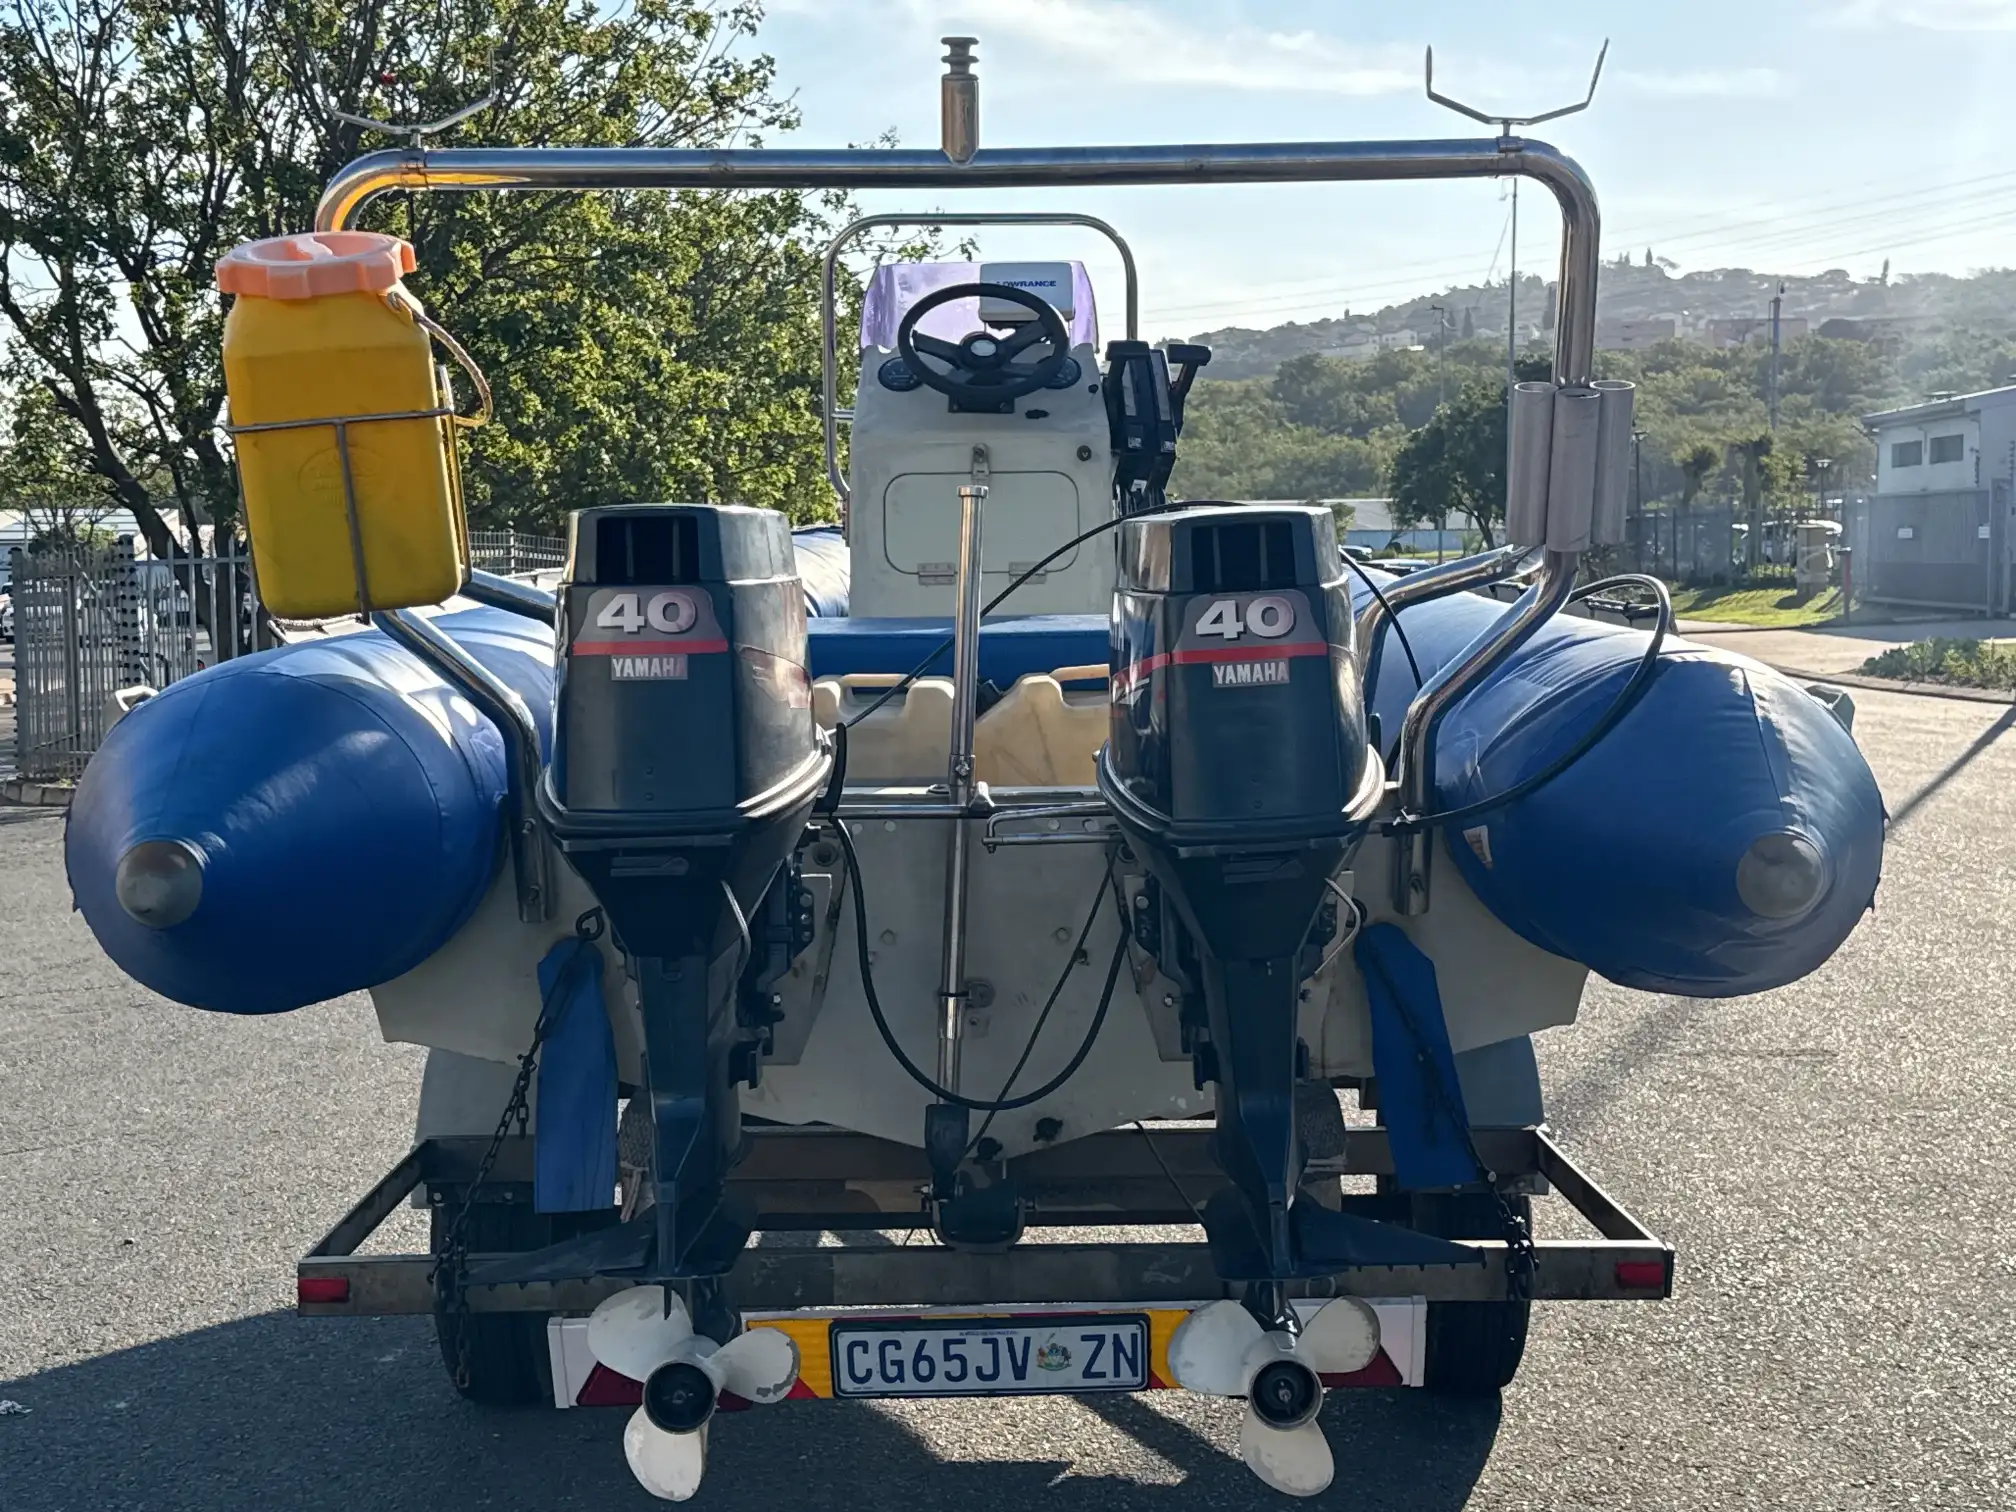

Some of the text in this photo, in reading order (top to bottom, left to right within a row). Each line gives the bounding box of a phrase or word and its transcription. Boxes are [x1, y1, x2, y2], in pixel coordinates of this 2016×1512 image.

[596, 592, 696, 632] 40
[1195, 597, 1294, 639] 40
[612, 657, 685, 677] YAMAHA
[1214, 661, 1288, 684] YAMAHA
[846, 1333, 1139, 1384] CG65JV ZN
